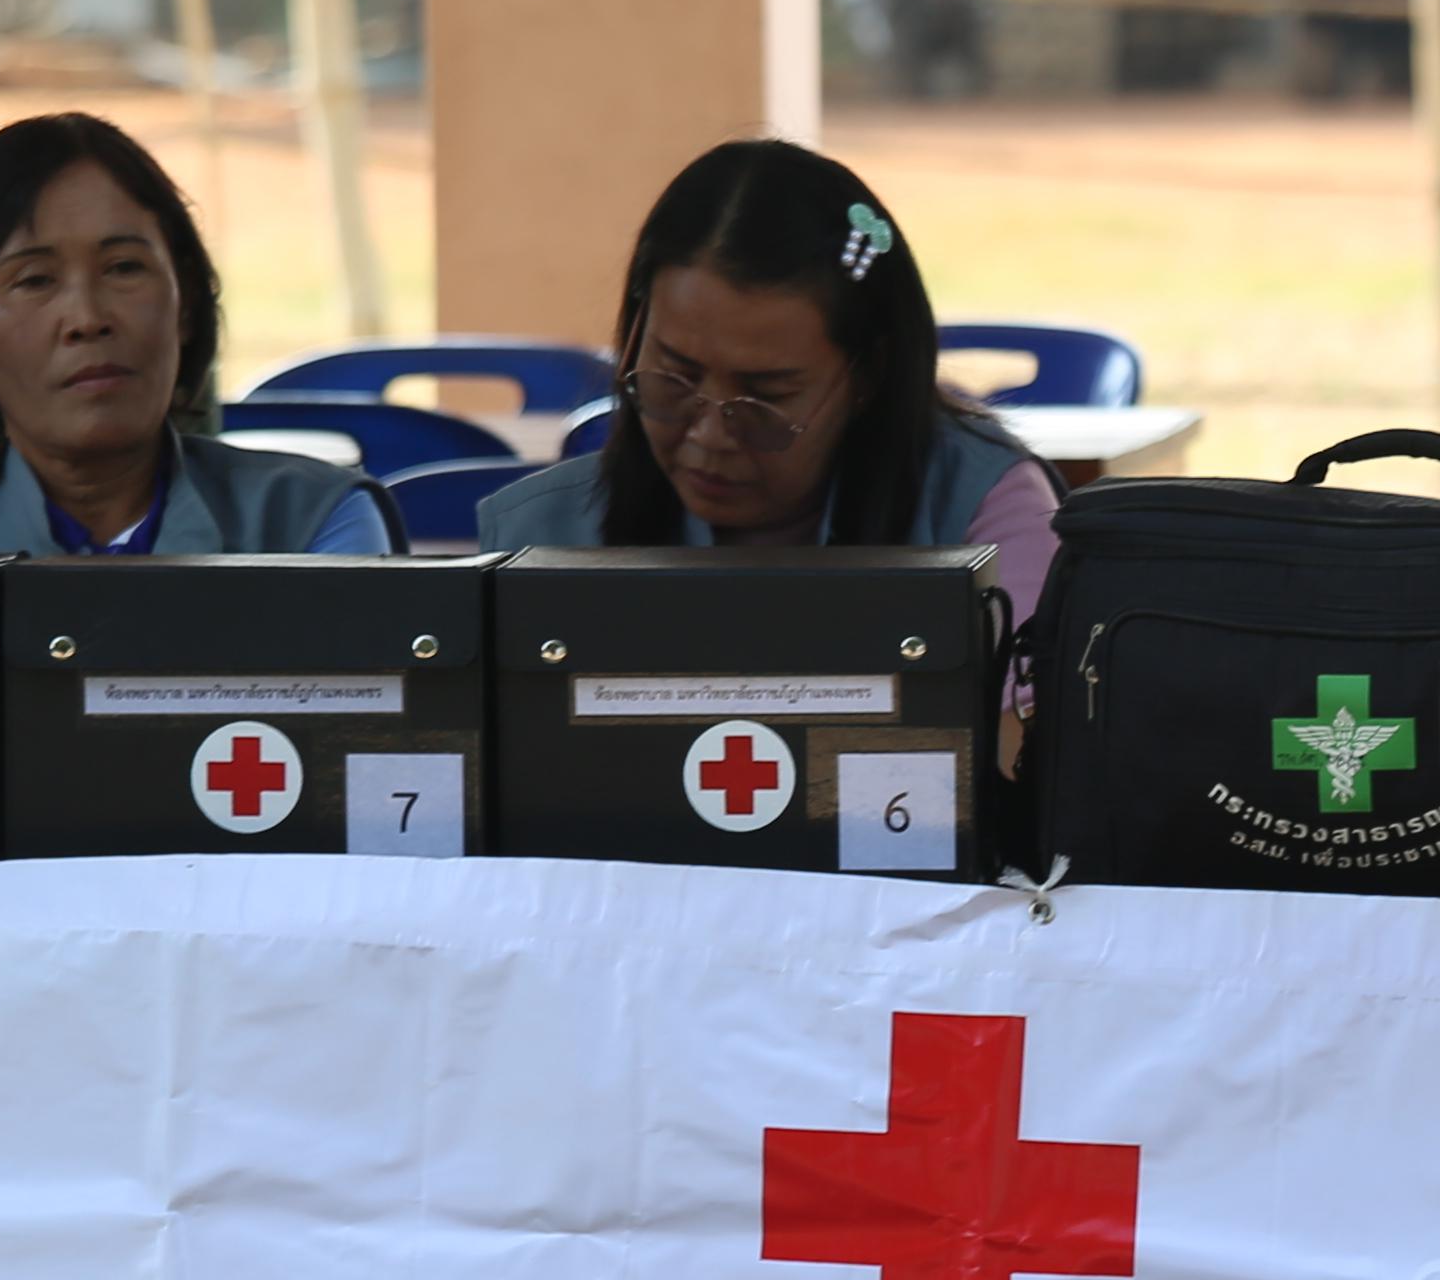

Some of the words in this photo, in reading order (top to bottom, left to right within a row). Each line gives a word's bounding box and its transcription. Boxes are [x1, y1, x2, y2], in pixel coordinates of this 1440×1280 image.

[391, 792, 419, 833] 7
[884, 791, 911, 833] 6
[1230, 831, 1291, 861] อ.ส.ม.
